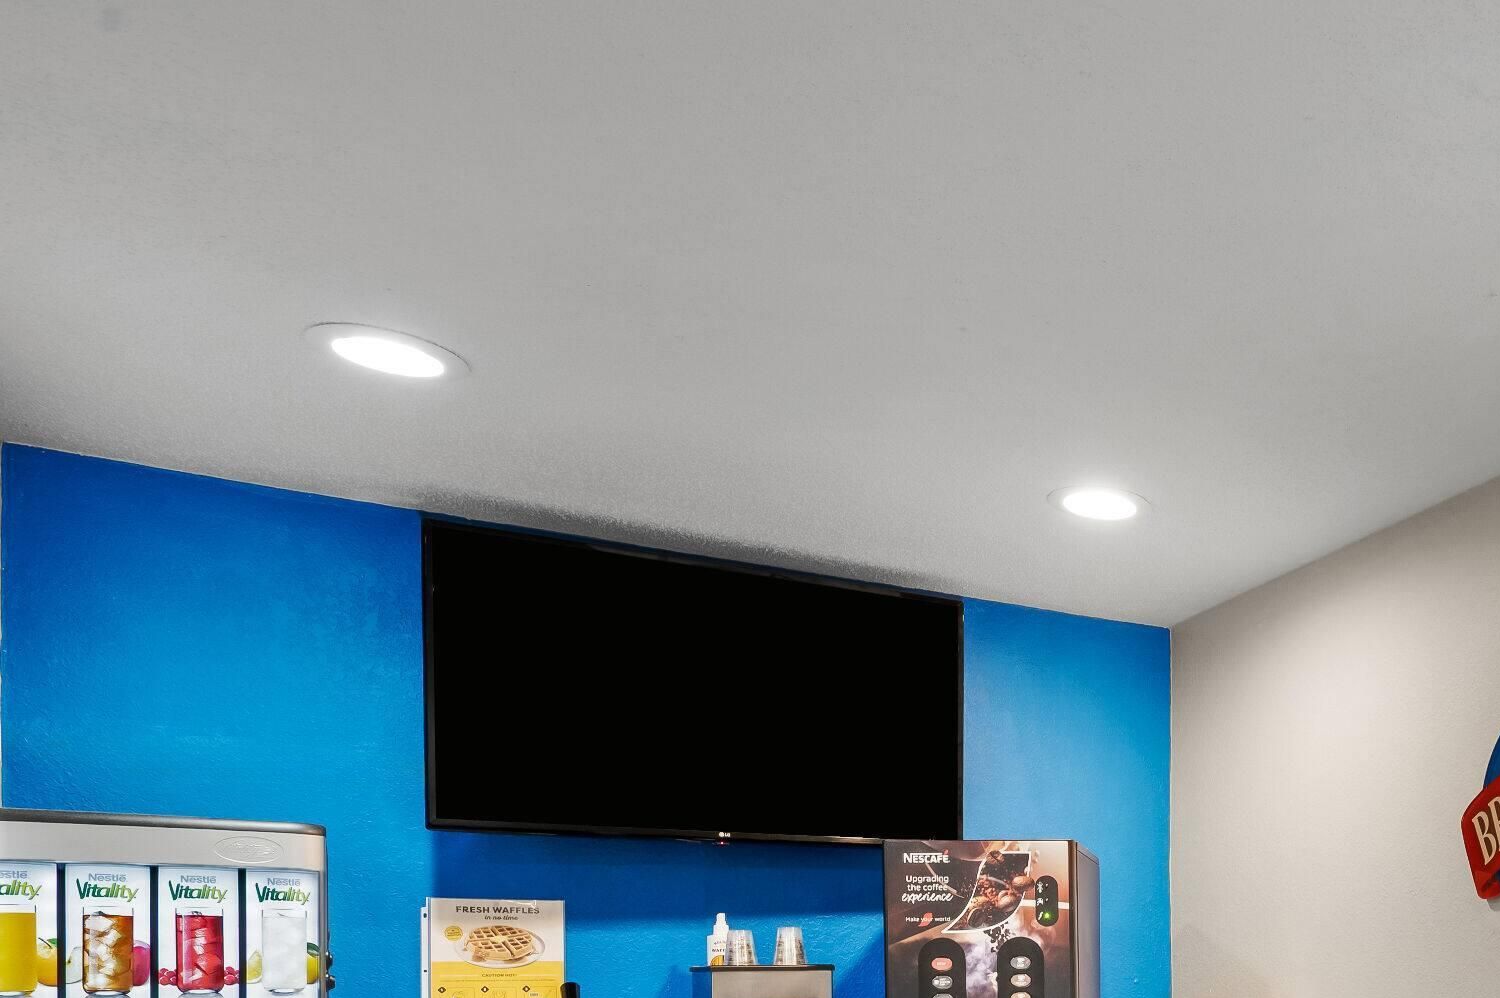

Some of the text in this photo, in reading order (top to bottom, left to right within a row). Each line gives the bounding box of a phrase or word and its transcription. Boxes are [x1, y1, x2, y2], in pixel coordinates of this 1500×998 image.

[0, 870, 28, 879] estlé
[905, 875, 949, 884] Upgrading
[0, 879, 43, 901] ality
[76, 878, 140, 903] Vitality
[168, 880, 228, 903] Vitality
[922, 883, 948, 891] coffee
[255, 882, 311, 905] Vitality
[901, 892, 954, 904] experience
[455, 906, 540, 915] FRESH WAFFLES
